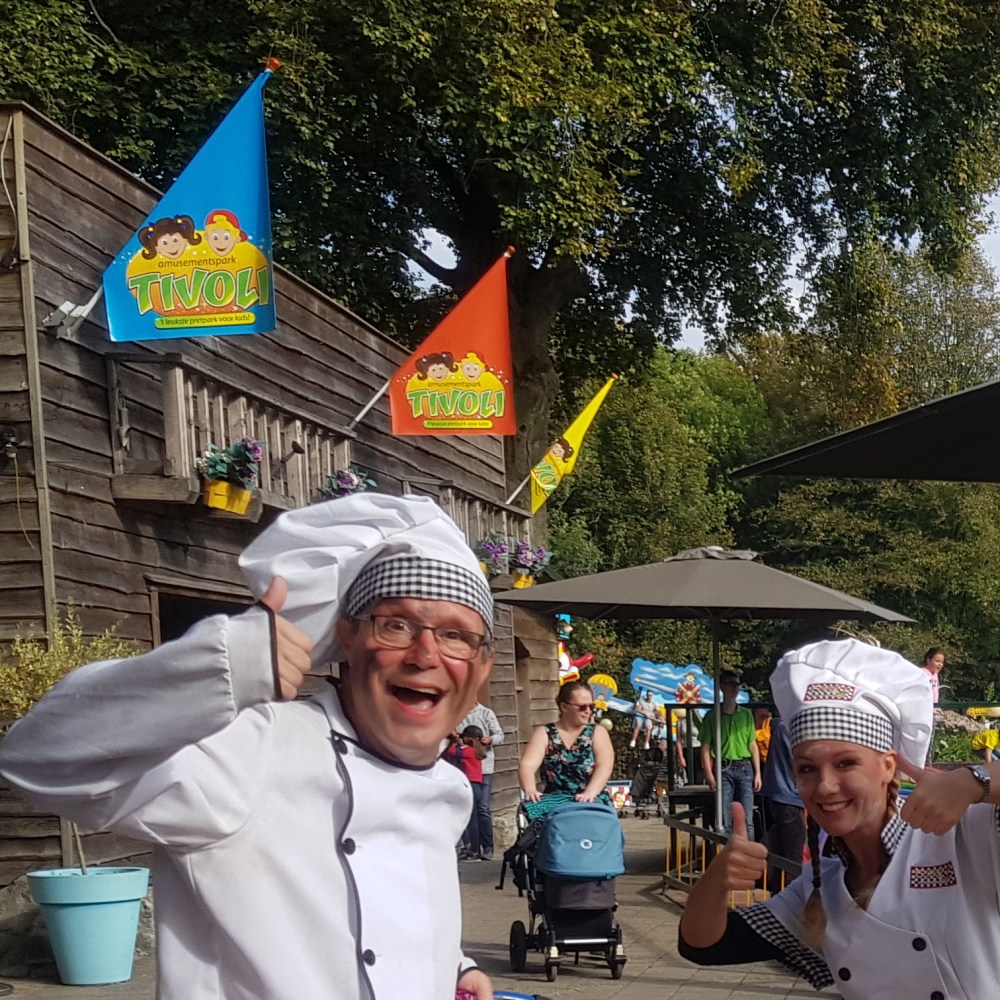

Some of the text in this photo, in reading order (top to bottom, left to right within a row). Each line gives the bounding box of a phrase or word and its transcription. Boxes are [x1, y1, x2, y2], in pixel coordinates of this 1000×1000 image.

[158, 255, 236, 268] amusementspark
[128, 266, 269, 316] TIVOLI
[407, 388, 505, 419] TIVOLI
